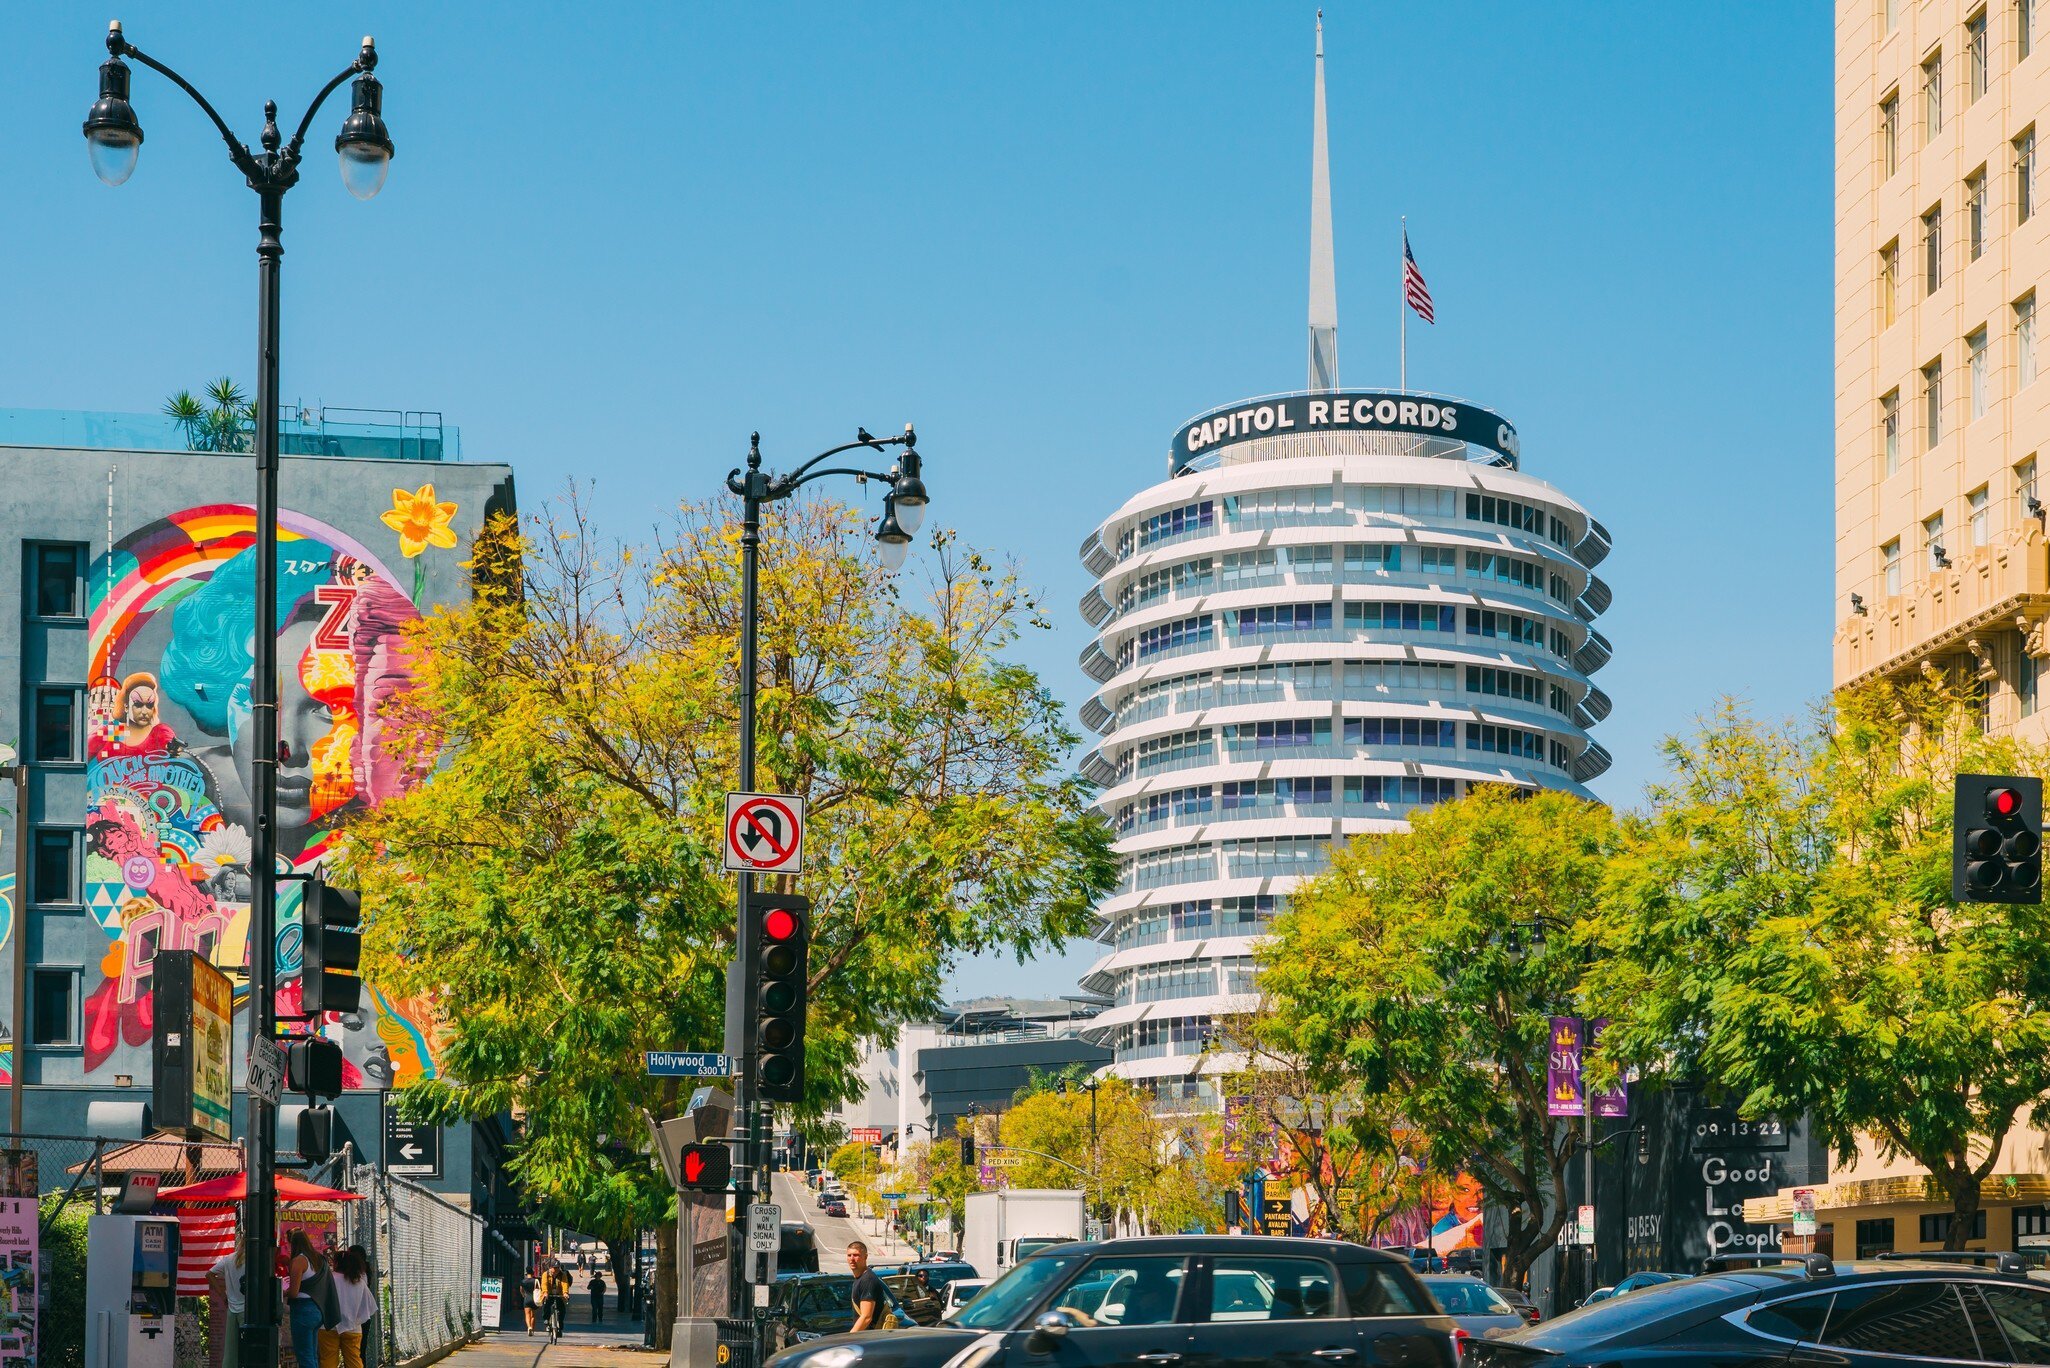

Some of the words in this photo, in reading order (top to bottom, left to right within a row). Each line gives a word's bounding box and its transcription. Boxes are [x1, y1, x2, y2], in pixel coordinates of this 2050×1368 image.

[1187, 404, 1294, 452] CAPITOL
[1309, 399, 1458, 431] RECORDS
[103, 787, 120, 796] LOS
[124, 790, 155, 820] ANGELES
[259, 1048, 282, 1071] CROSSING
[650, 1053, 705, 1069] Hollywood
[717, 1055, 727, 1067] Bl
[1550, 1051, 1581, 1071] SIX
[698, 1066, 718, 1075] 6300
[721, 1067, 727, 1075] W
[251, 1064, 265, 1089] OK
[852, 1134, 880, 1142] HOTEL
[1702, 1157, 1771, 1185] Good
[132, 1177, 157, 1187] ATM
[13, 1202, 20, 1213] 1
[754, 1207, 777, 1215] CROSS
[11, 1226, 22, 1234] Hills
[145, 1226, 163, 1237] ATM
[757, 1223, 774, 1231] WALK
[18, 1237, 30, 1246] hotel
[753, 1232, 776, 1240] SIGNAL
